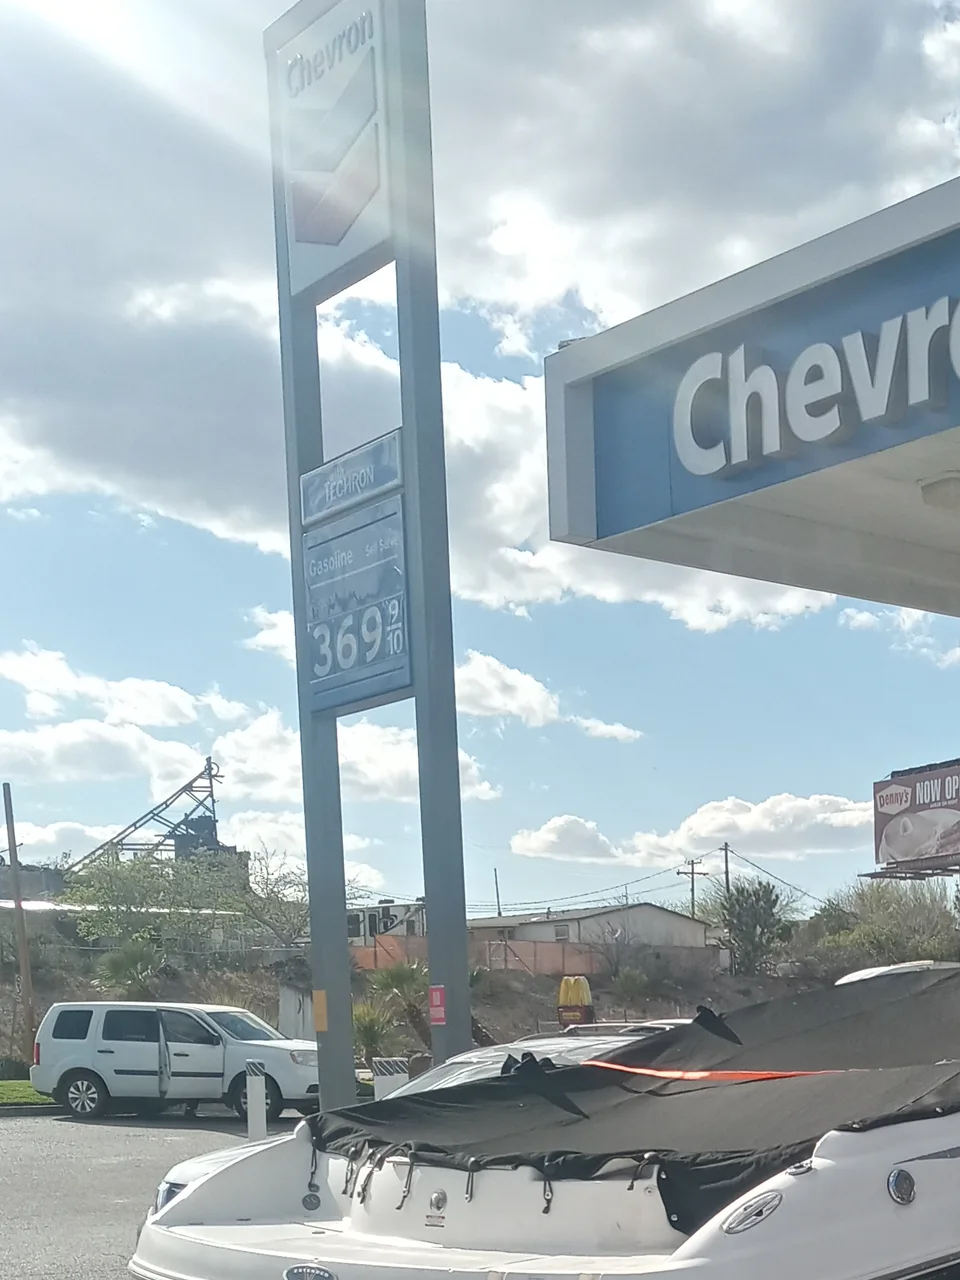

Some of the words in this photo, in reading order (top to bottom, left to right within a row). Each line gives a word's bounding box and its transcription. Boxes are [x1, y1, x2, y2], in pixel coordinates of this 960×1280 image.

[286, 10, 374, 98] Chevron
[324, 465, 375, 503] TECHRON
[309, 549, 354, 577] Gasoline
[313, 605, 383, 677] 369
[878, 789, 910, 809] Denny's
[915, 778, 942, 806] NOW
